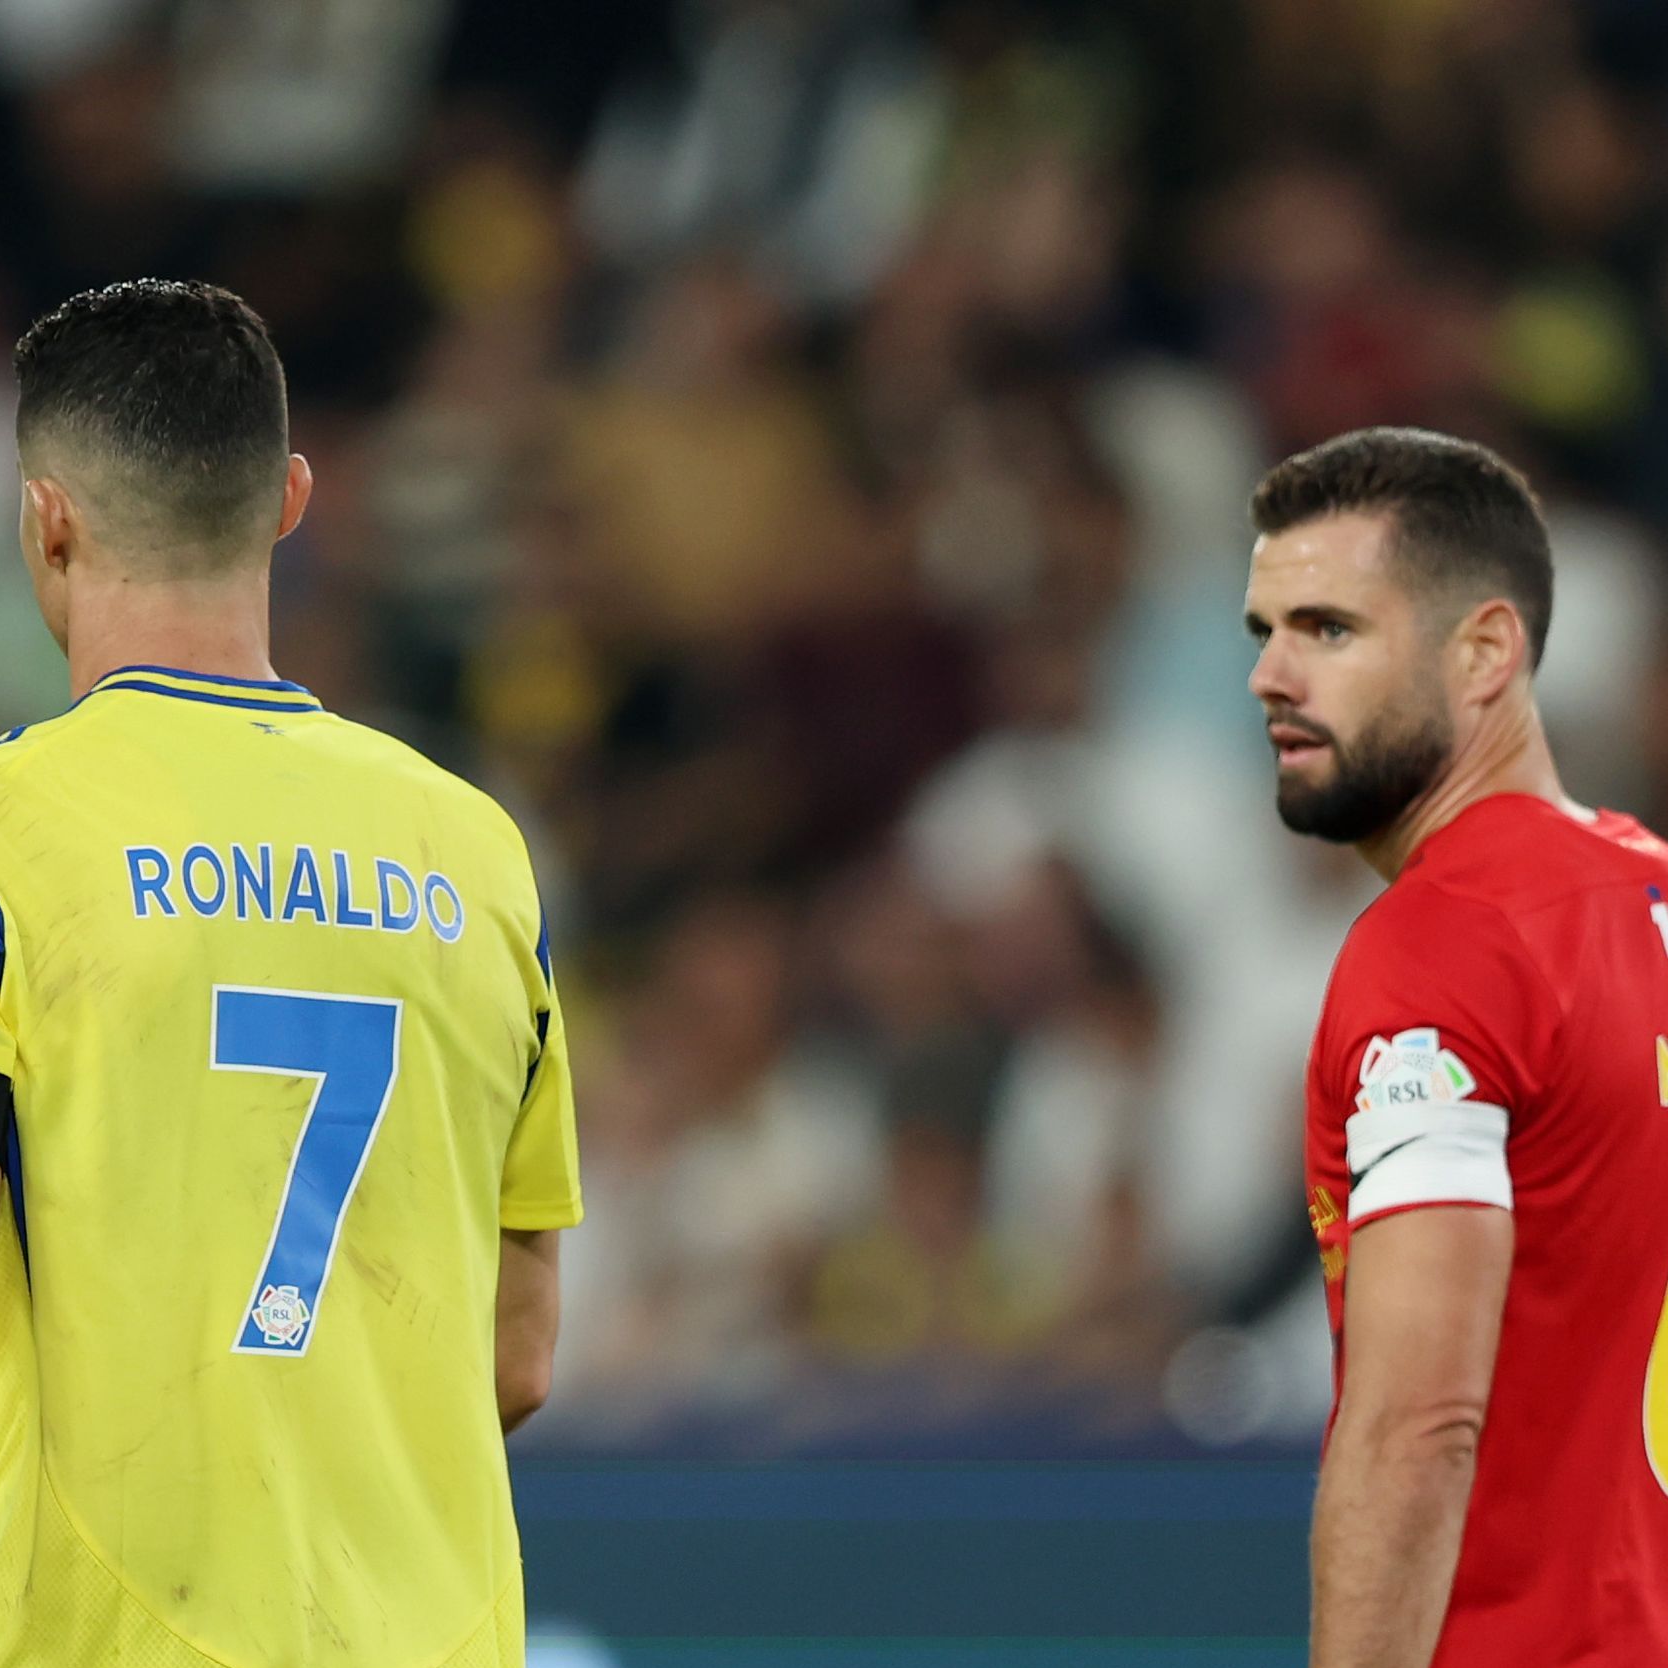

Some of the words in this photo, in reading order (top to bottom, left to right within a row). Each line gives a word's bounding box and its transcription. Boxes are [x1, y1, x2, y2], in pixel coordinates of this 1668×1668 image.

[124, 842, 465, 944] RONALDO
[1388, 1080, 1430, 1104] RSL
[209, 984, 403, 1358] 7
[272, 1308, 291, 1320] RSL
